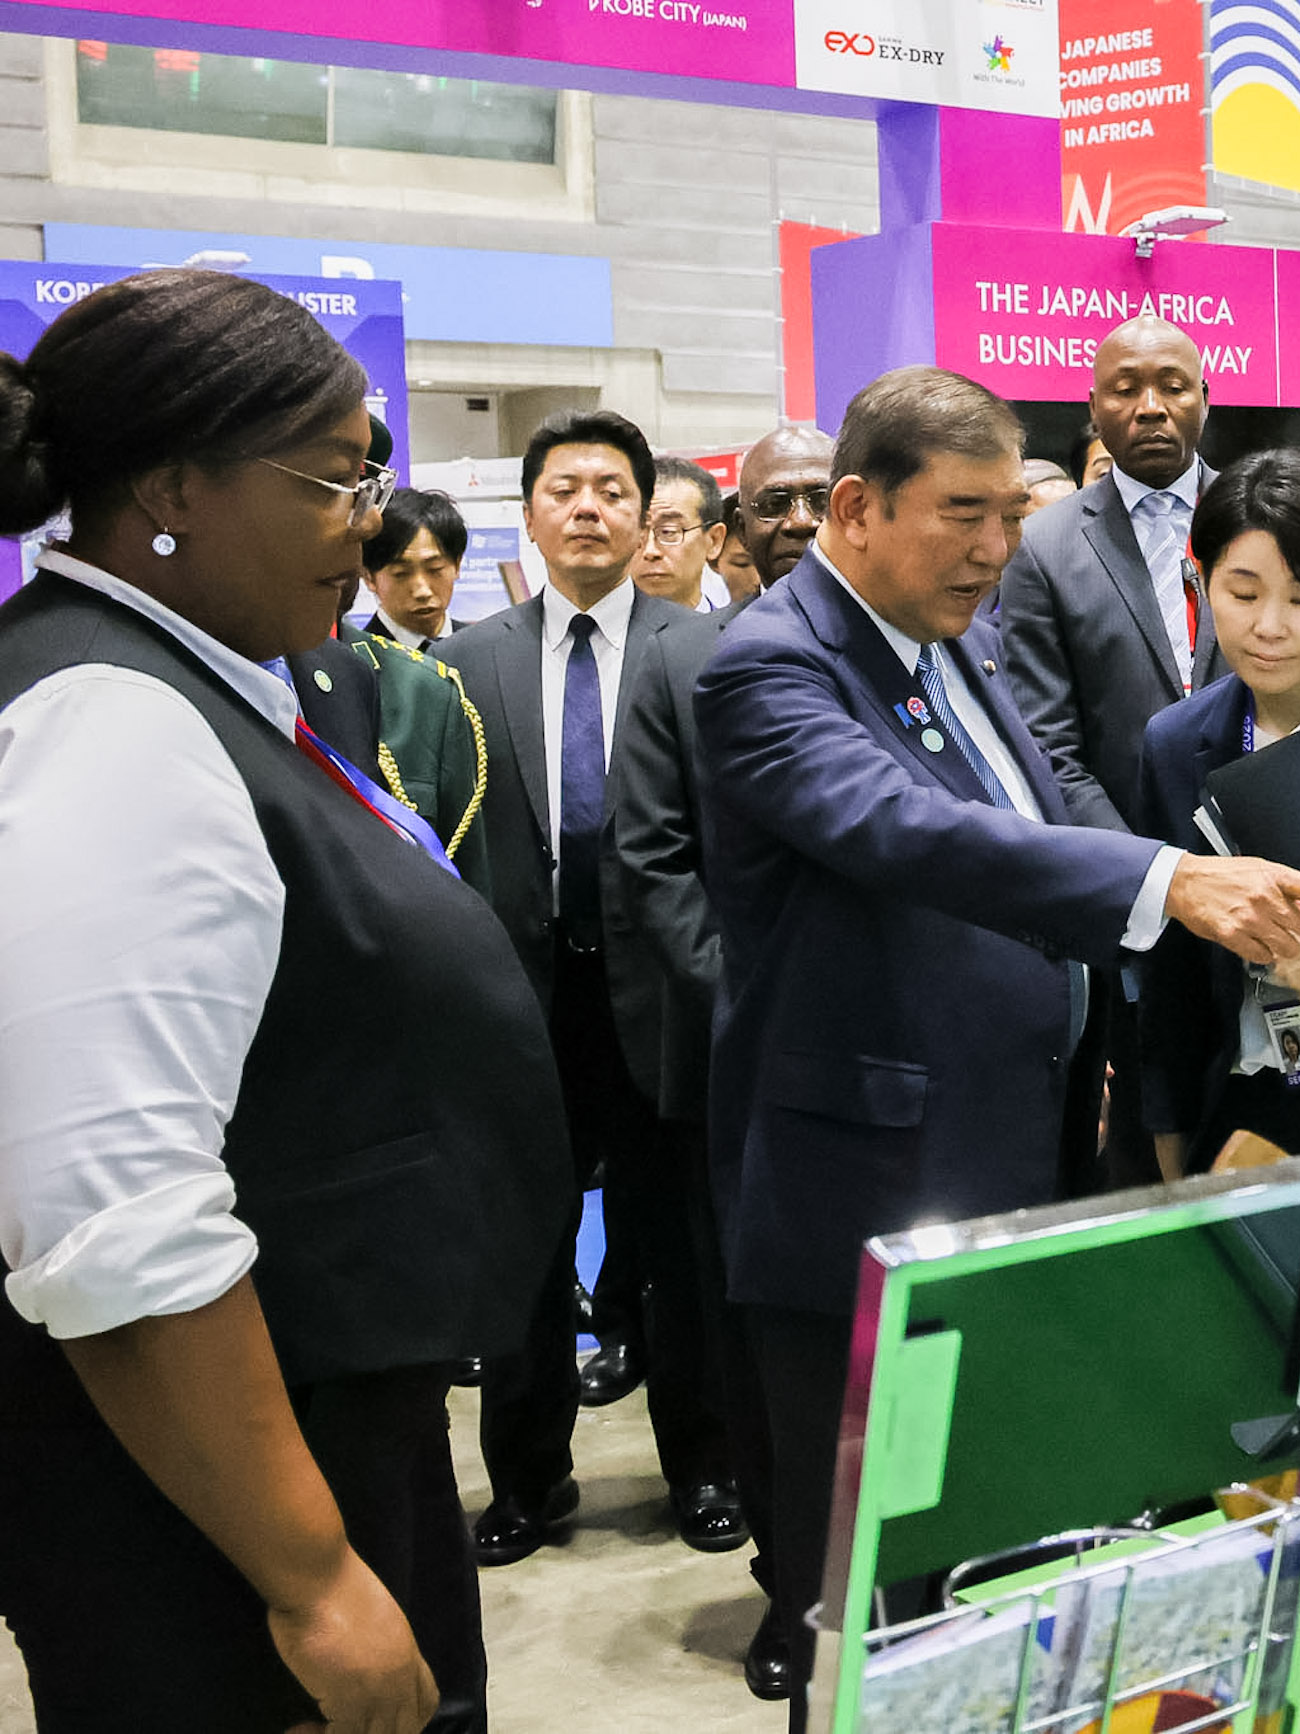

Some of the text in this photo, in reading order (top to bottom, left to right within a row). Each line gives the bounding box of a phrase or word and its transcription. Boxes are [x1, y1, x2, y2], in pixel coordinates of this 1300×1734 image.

[602, 0, 748, 31] KOBE CITY (JAPAN)
[1061, 28, 1153, 60] JAPANESE
[1059, 57, 1162, 90] COMPANIES
[1059, 83, 1190, 119] VING GROWTH
[1064, 118, 1154, 148] IN AFRICA
[976, 281, 1235, 326] THE JAPAN-AFRICA
[979, 333, 1253, 374] BUSINES WAY
